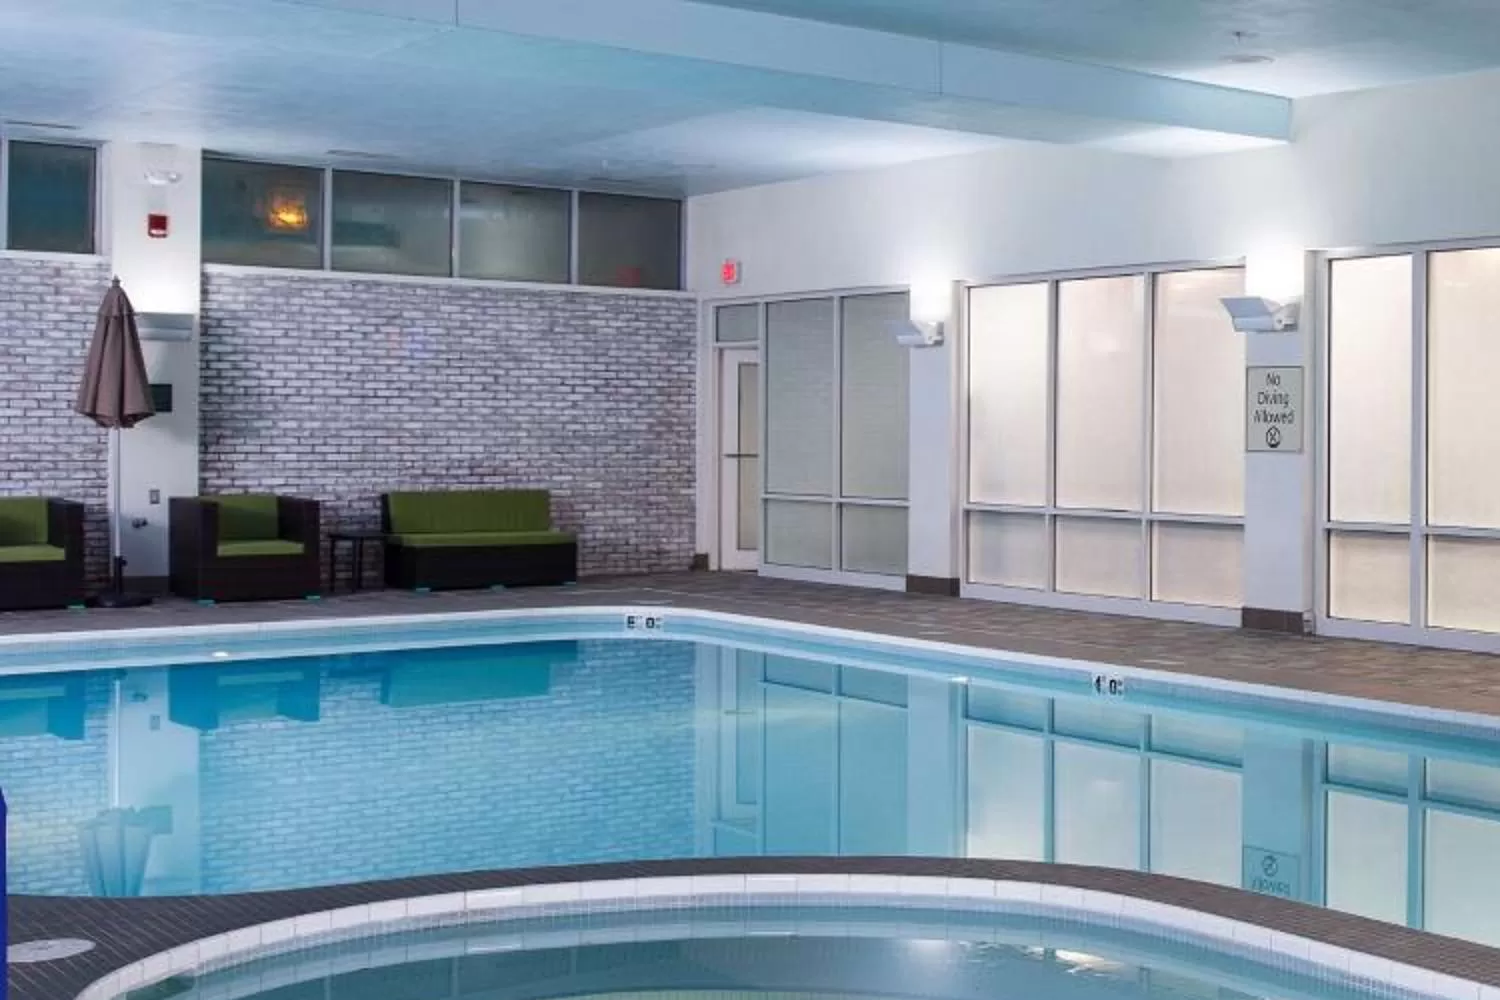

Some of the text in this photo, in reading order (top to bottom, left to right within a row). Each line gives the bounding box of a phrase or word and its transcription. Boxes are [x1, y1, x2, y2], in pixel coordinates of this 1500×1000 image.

[1265, 372, 1281, 386] No
[1257, 390, 1289, 408] Diving
[1253, 409, 1295, 424] Allowed
